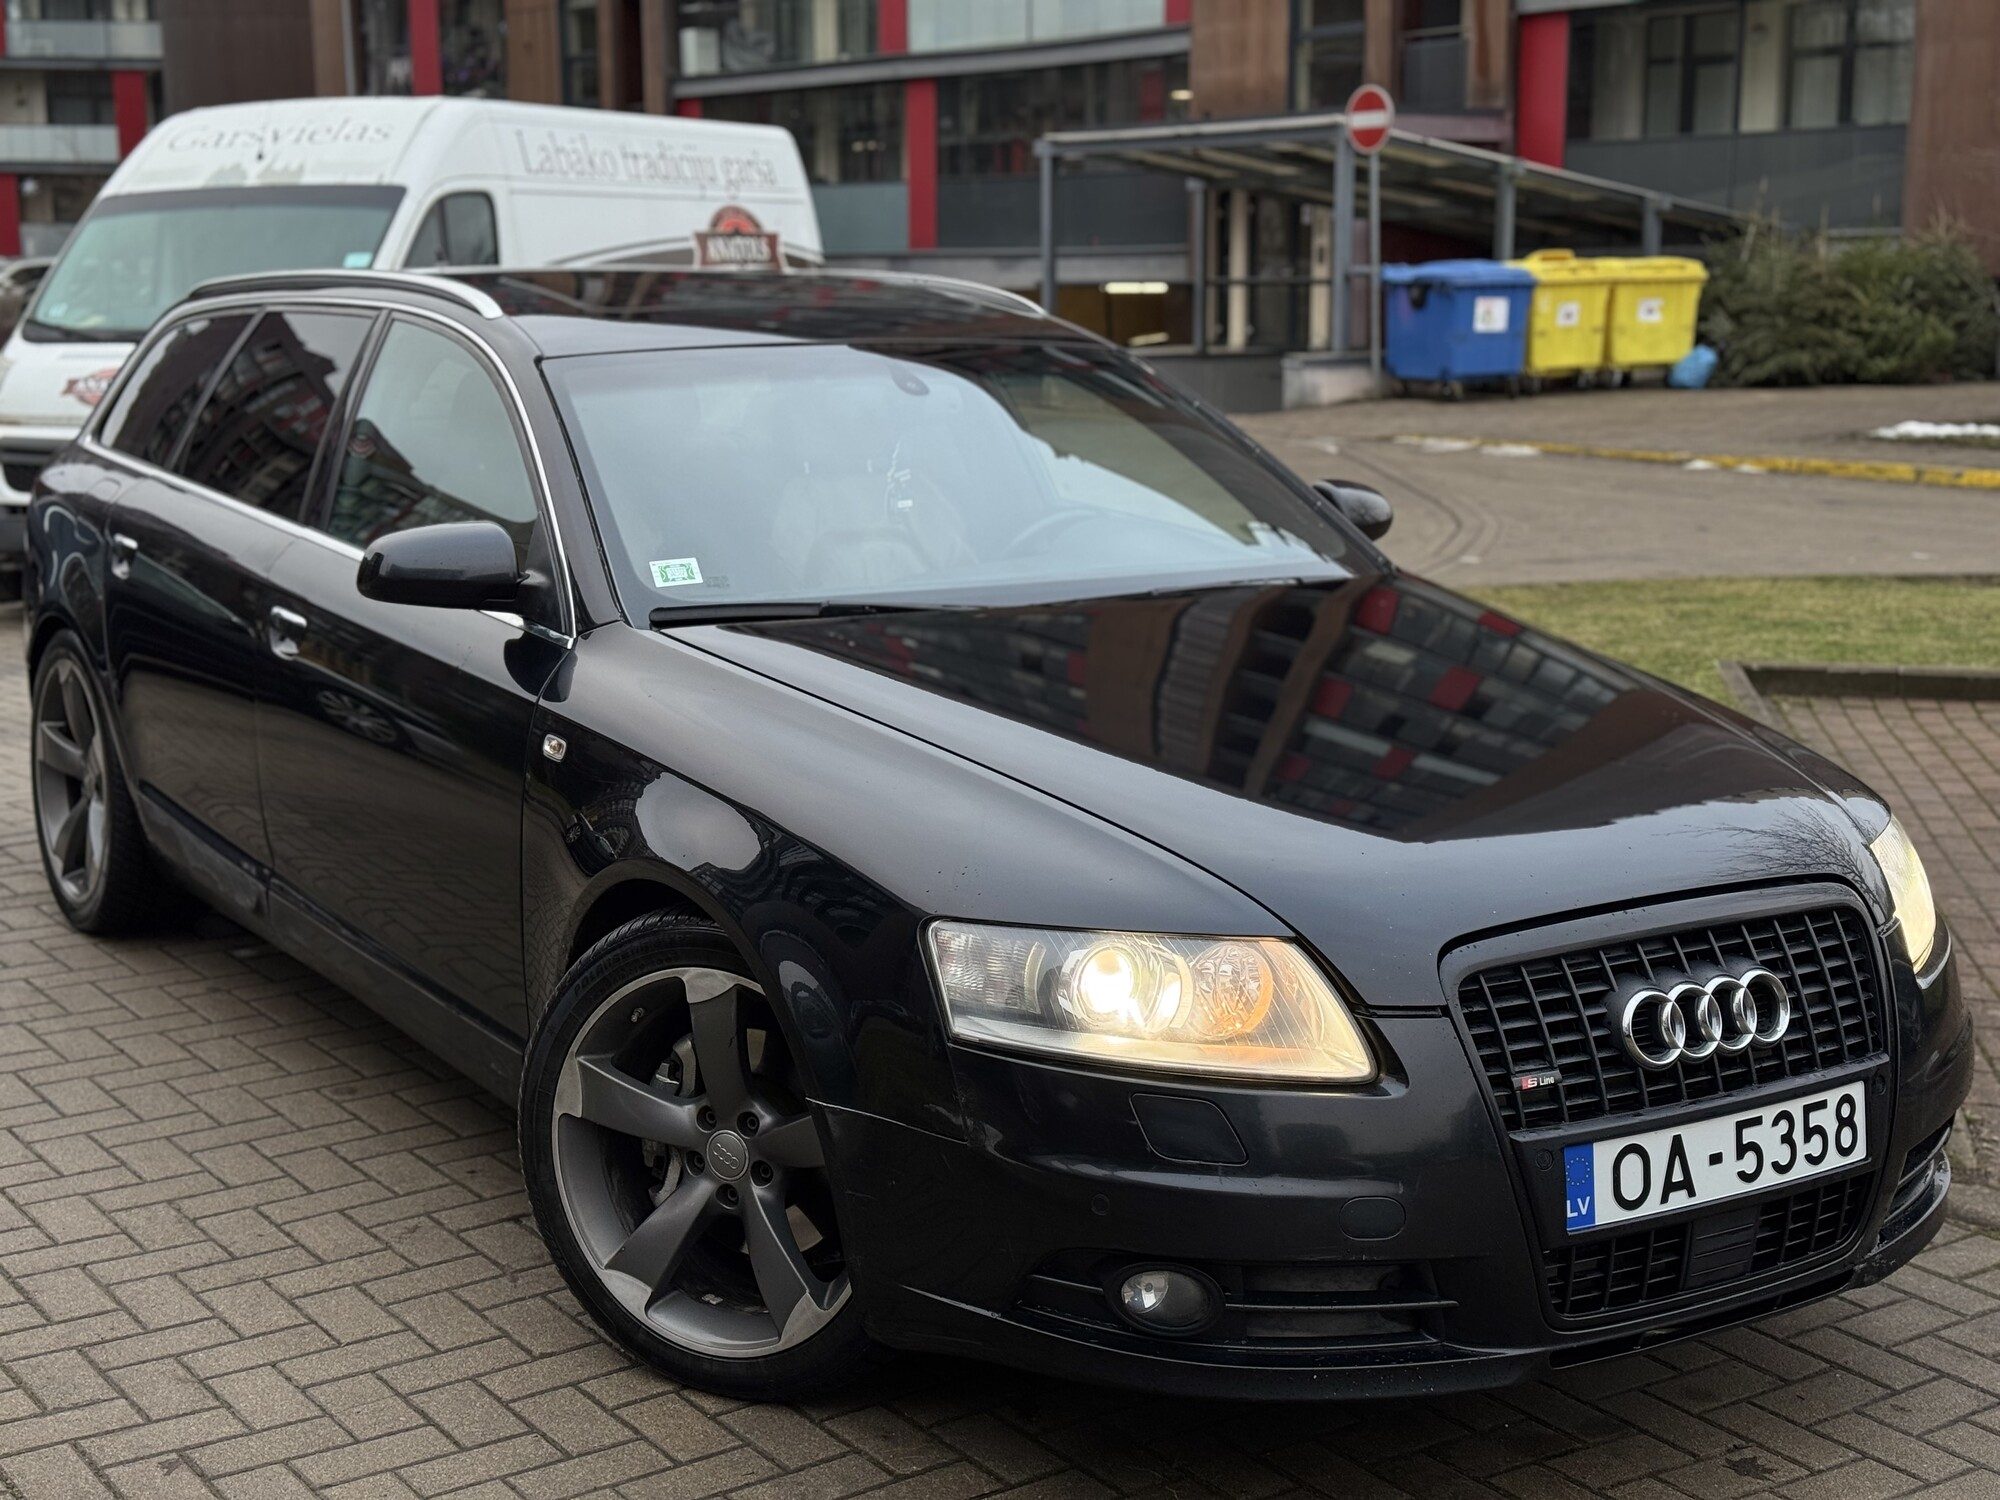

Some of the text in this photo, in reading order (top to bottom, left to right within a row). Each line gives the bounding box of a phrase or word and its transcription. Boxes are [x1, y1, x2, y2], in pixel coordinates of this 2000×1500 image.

[1527, 1077, 1538, 1088] S
[1611, 1093, 1859, 1211] OA-5358
[1566, 1196, 1591, 1218] LV
